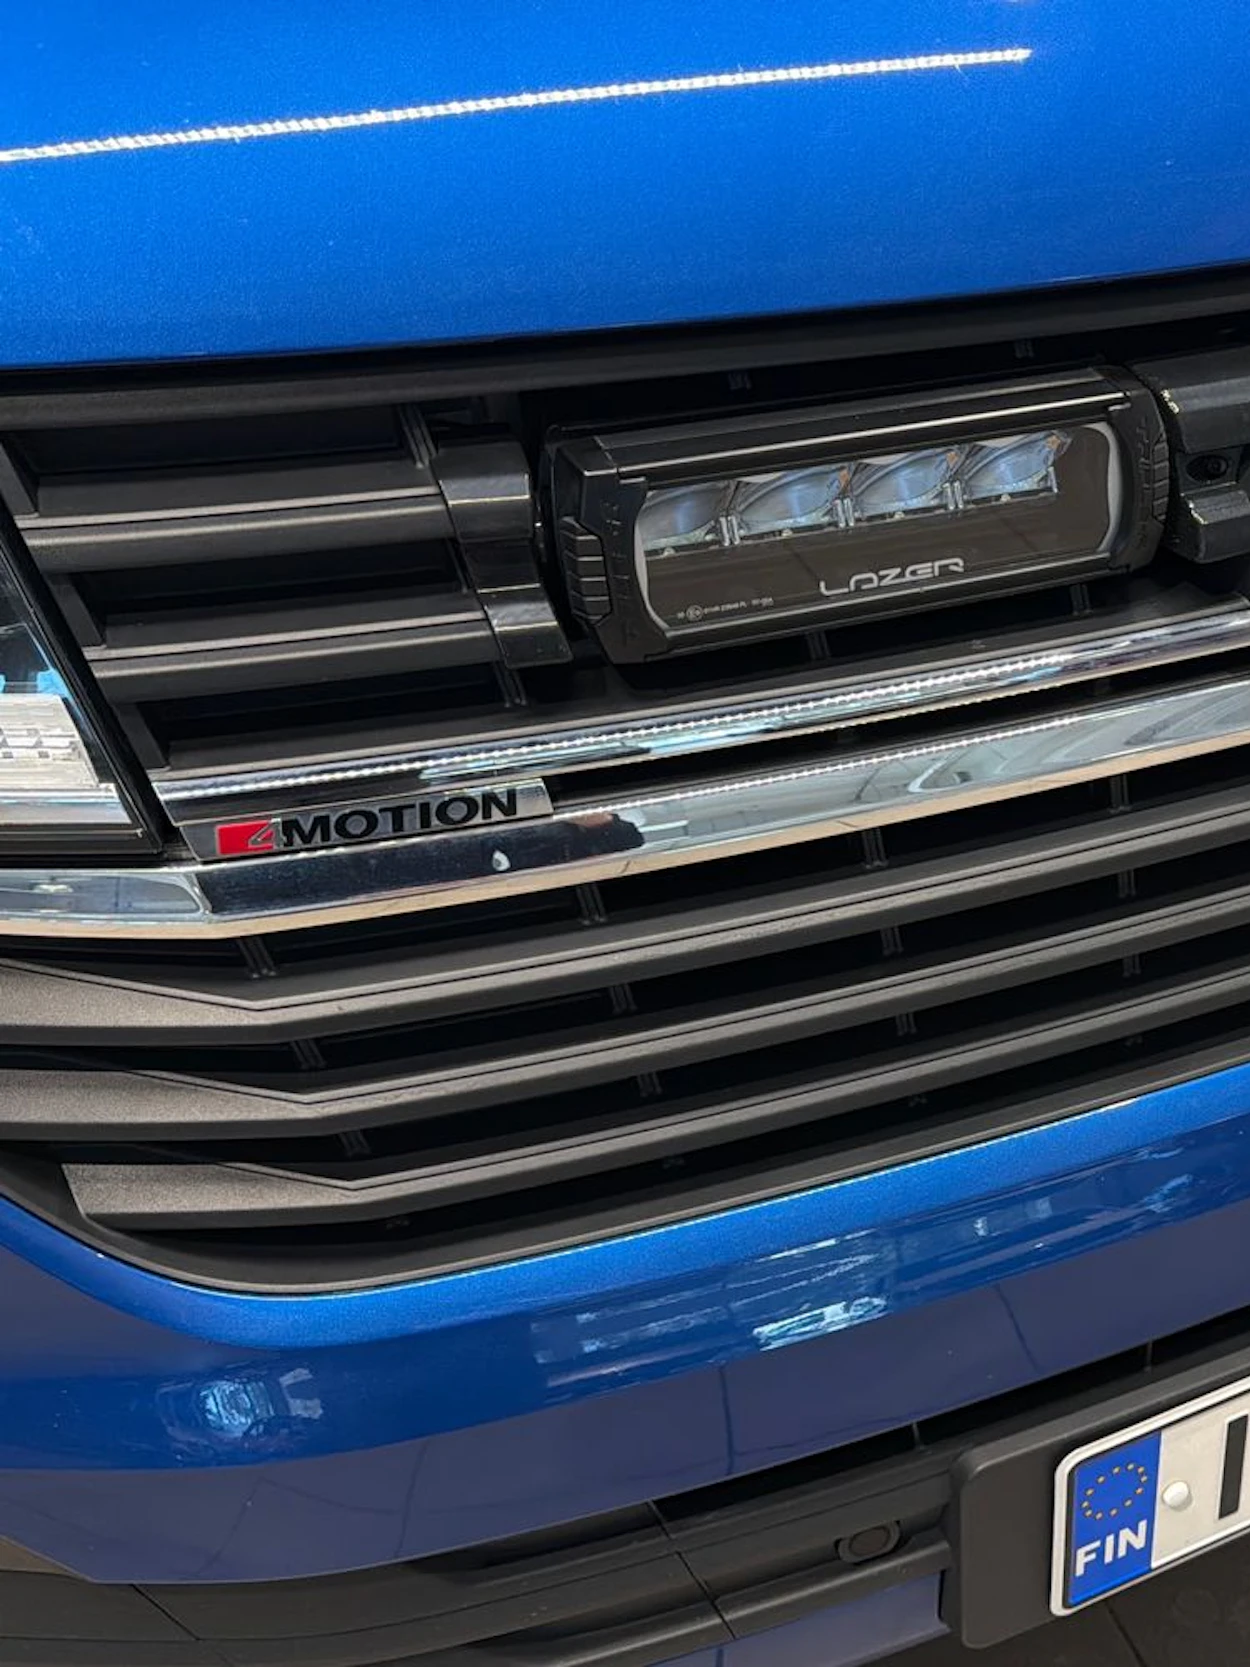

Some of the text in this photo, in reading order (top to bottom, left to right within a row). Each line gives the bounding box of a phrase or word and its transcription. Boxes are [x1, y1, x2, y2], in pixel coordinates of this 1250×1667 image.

[819, 557, 965, 597] LAZER
[246, 788, 517, 849] 4MOTION
[1075, 1519, 1147, 1577] FIN
